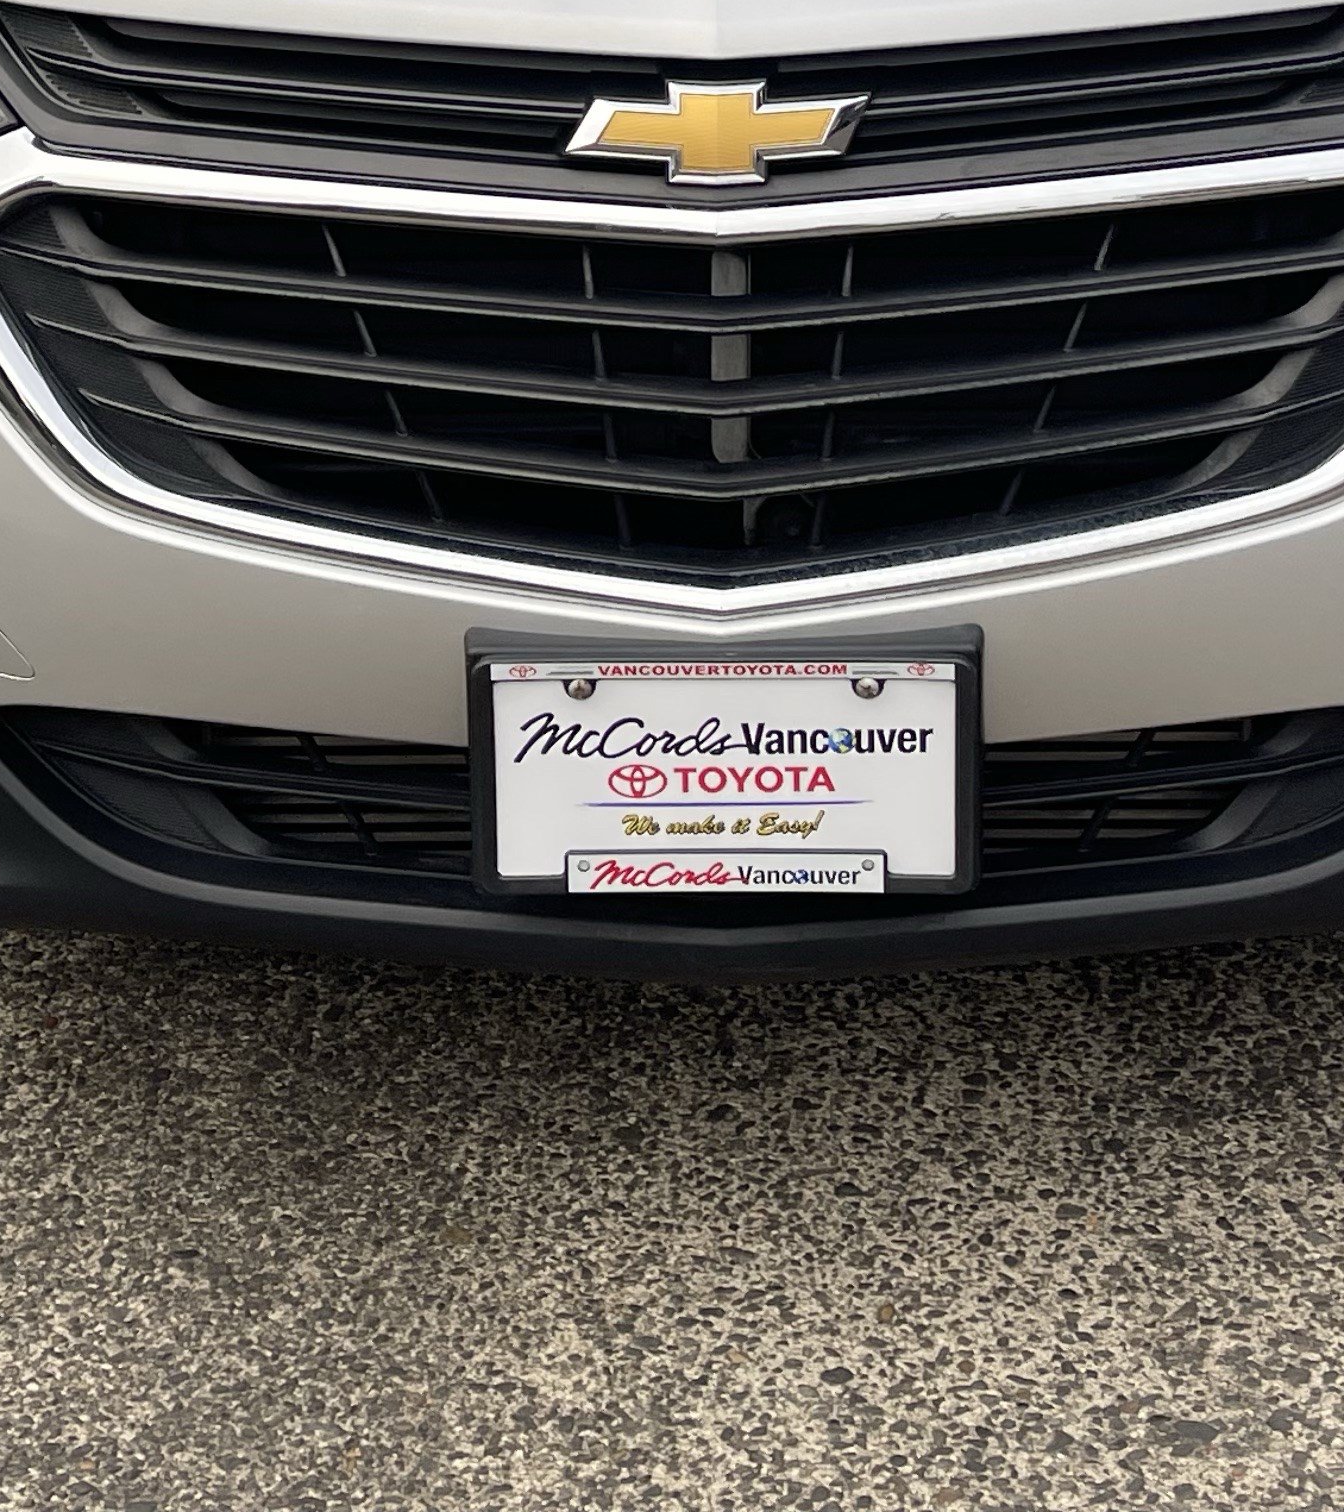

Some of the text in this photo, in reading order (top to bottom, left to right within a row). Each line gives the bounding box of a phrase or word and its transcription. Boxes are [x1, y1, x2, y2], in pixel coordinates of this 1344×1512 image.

[597, 663, 848, 677] VANCOUVERTOYOTA.COM
[674, 766, 836, 793] TOYOTA
[621, 810, 825, 839] We make it Easy!
